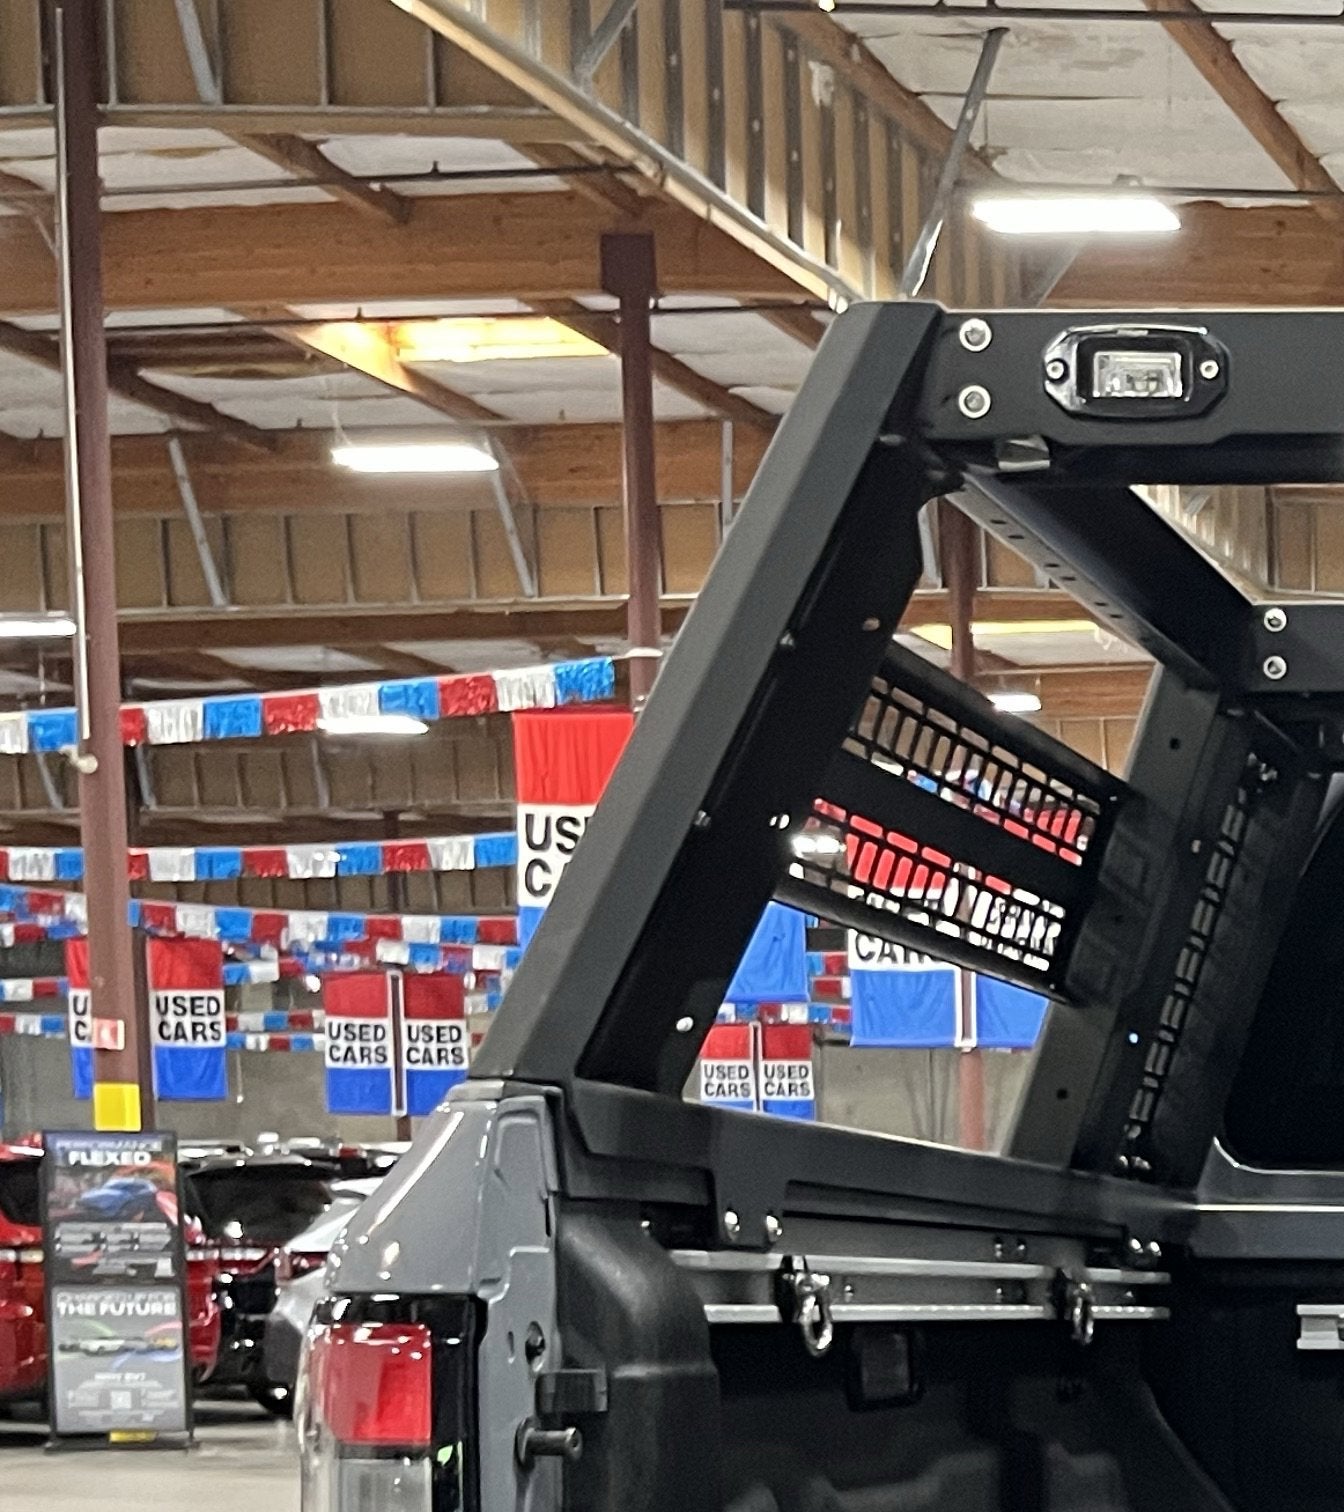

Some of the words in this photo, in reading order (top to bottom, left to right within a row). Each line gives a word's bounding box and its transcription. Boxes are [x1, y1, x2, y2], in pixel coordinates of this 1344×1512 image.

[155, 996, 221, 1016] USED
[158, 1021, 222, 1041] CARS
[328, 1022, 386, 1042] USED
[407, 1024, 462, 1043] USED
[329, 1044, 388, 1064] CARS
[406, 1047, 464, 1065] CARS
[704, 1064, 749, 1080] USED
[764, 1064, 809, 1080] USED
[705, 1082, 751, 1097] CARS
[764, 1082, 810, 1097] CARS
[58, 1301, 97, 1316] THE
[99, 1301, 177, 1316] FUTURE
